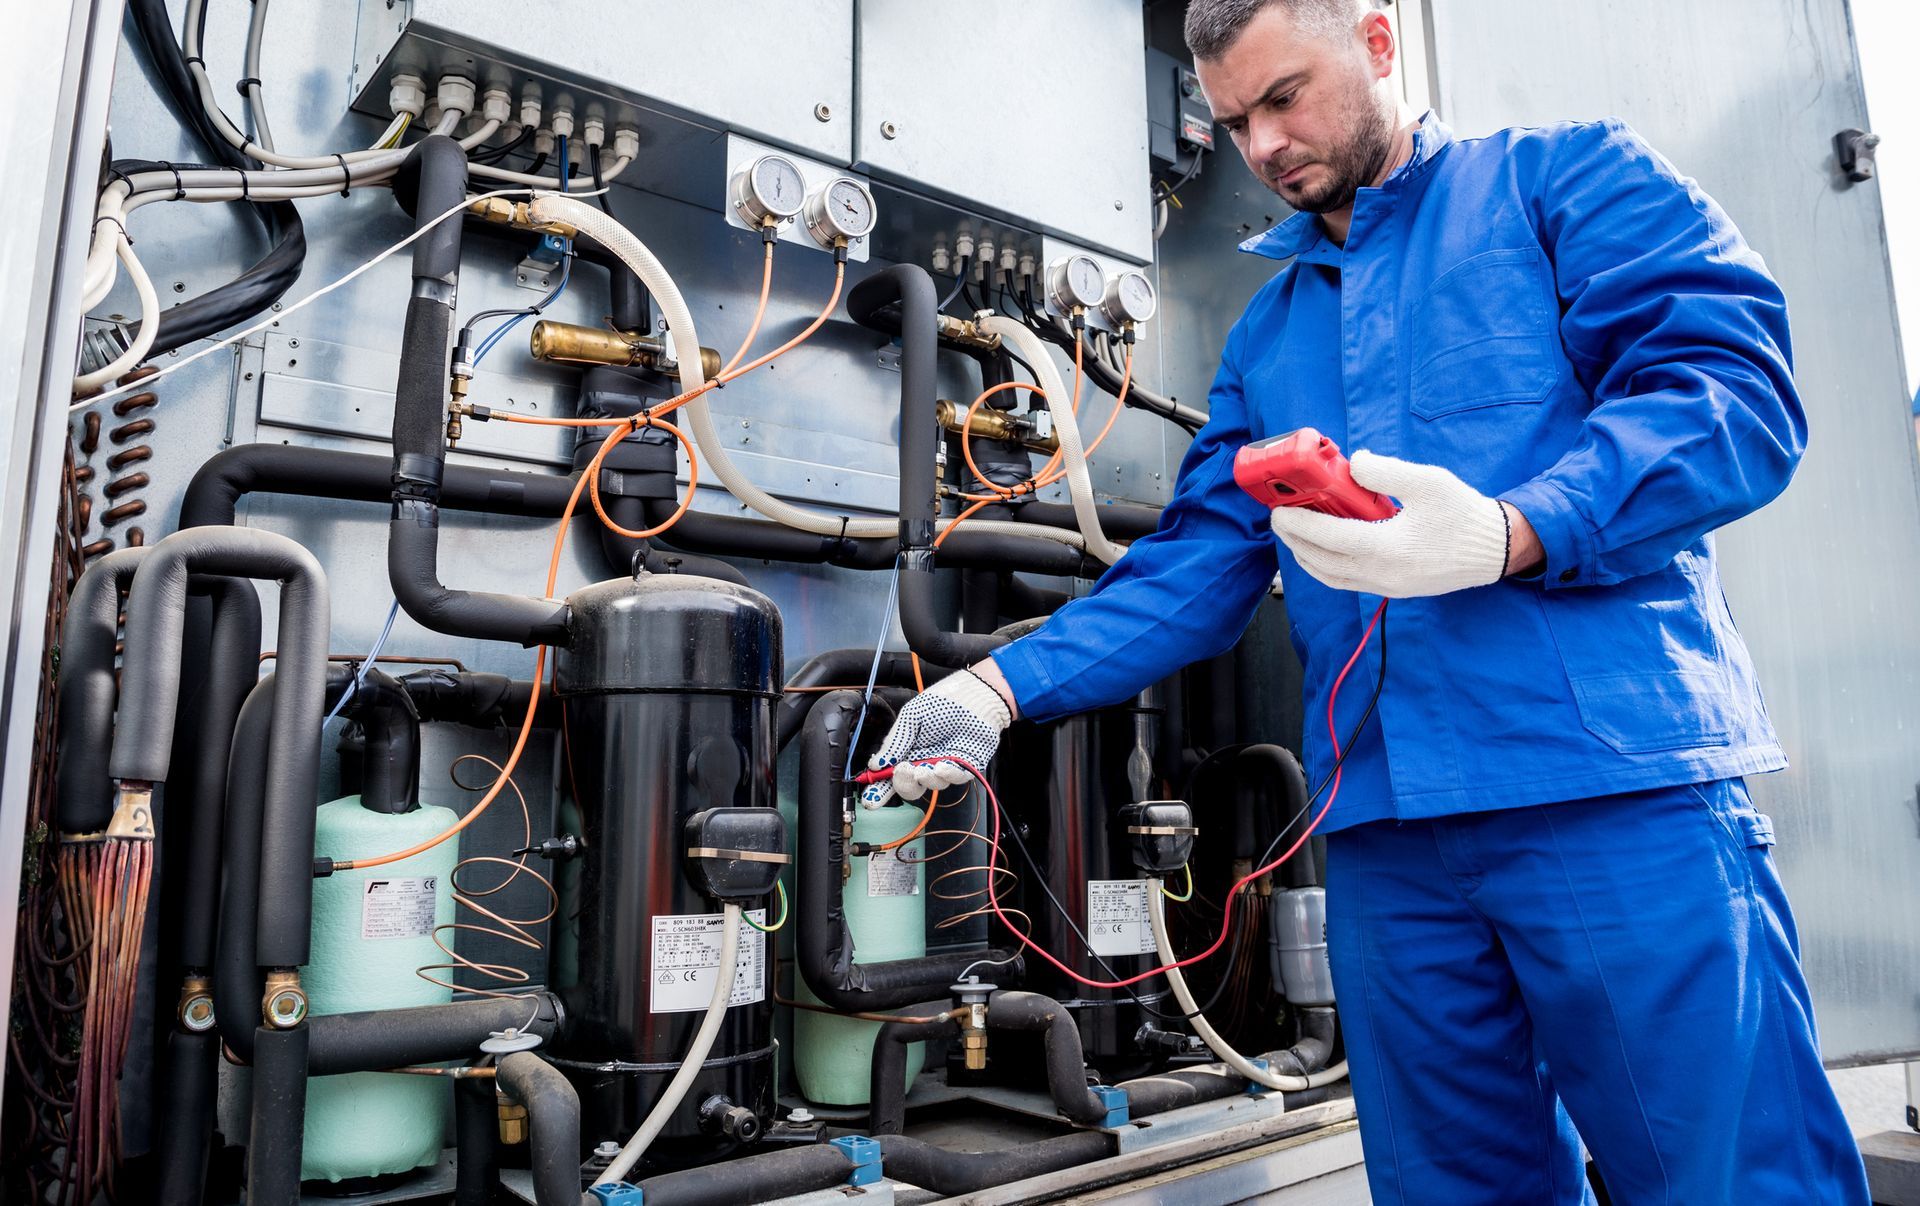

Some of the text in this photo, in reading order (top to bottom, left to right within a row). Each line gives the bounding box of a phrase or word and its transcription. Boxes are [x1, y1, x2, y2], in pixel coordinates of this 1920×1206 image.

[133, 807, 152, 834] 2
[1112, 924, 1122, 933] CE
[684, 970, 696, 981] CE
